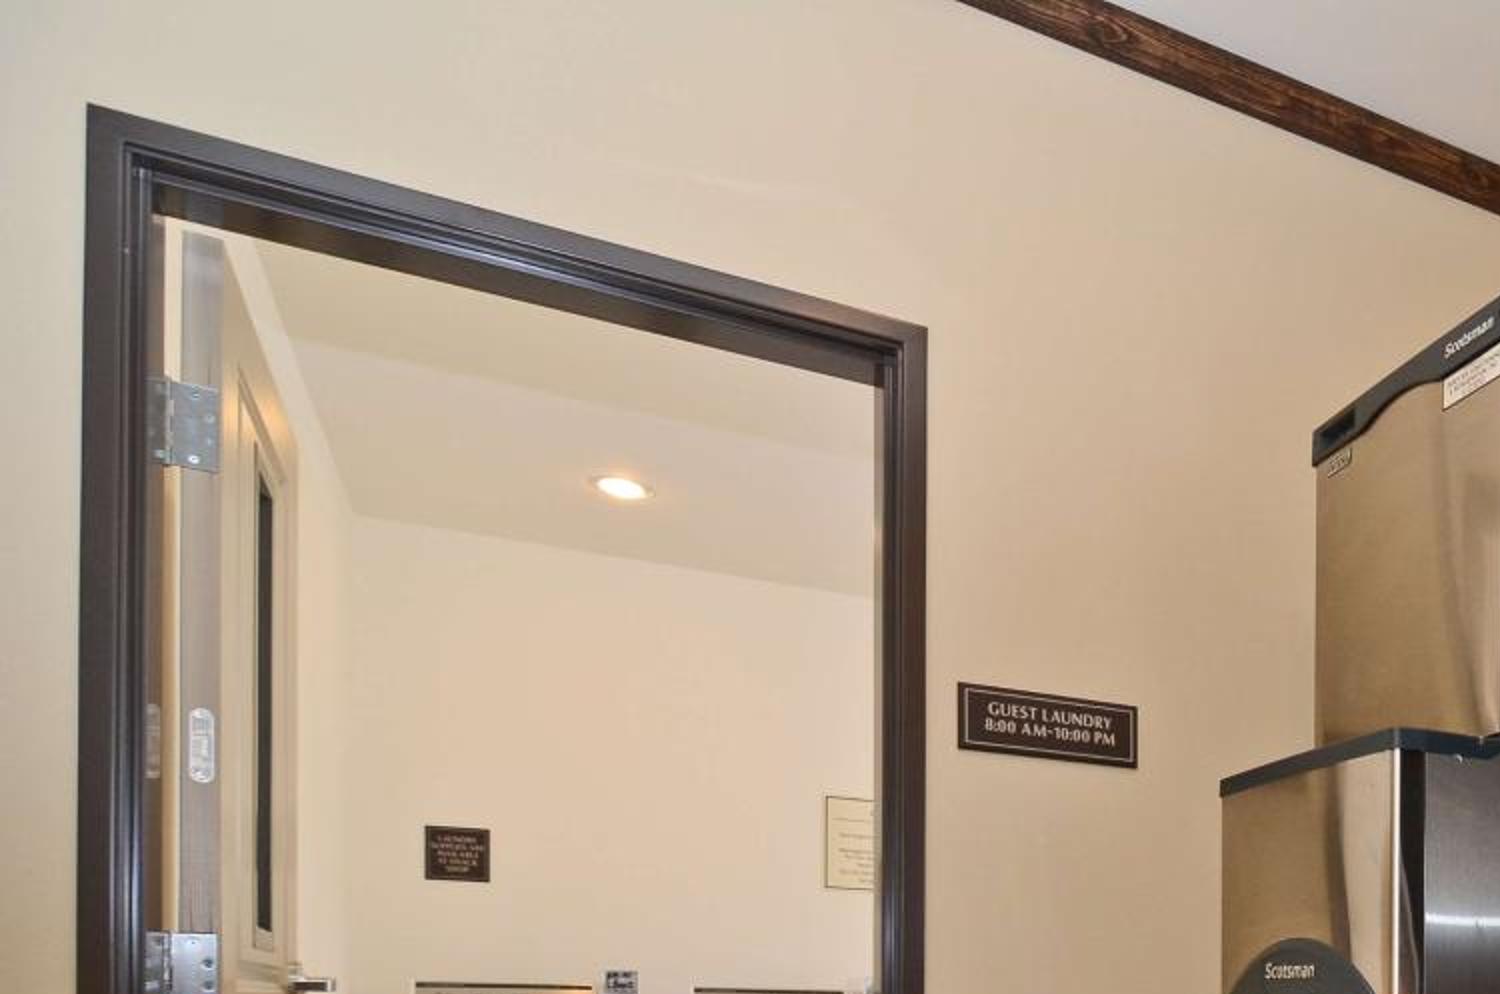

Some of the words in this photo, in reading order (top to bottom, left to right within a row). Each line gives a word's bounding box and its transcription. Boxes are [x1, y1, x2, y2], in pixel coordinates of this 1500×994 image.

[988, 701, 1037, 721] GUEST
[1042, 709, 1113, 730] LAUNDRY
[985, 719, 1016, 734] 8:00
[1093, 733, 1116, 747] PM
[1264, 962, 1315, 980] Scotsman
